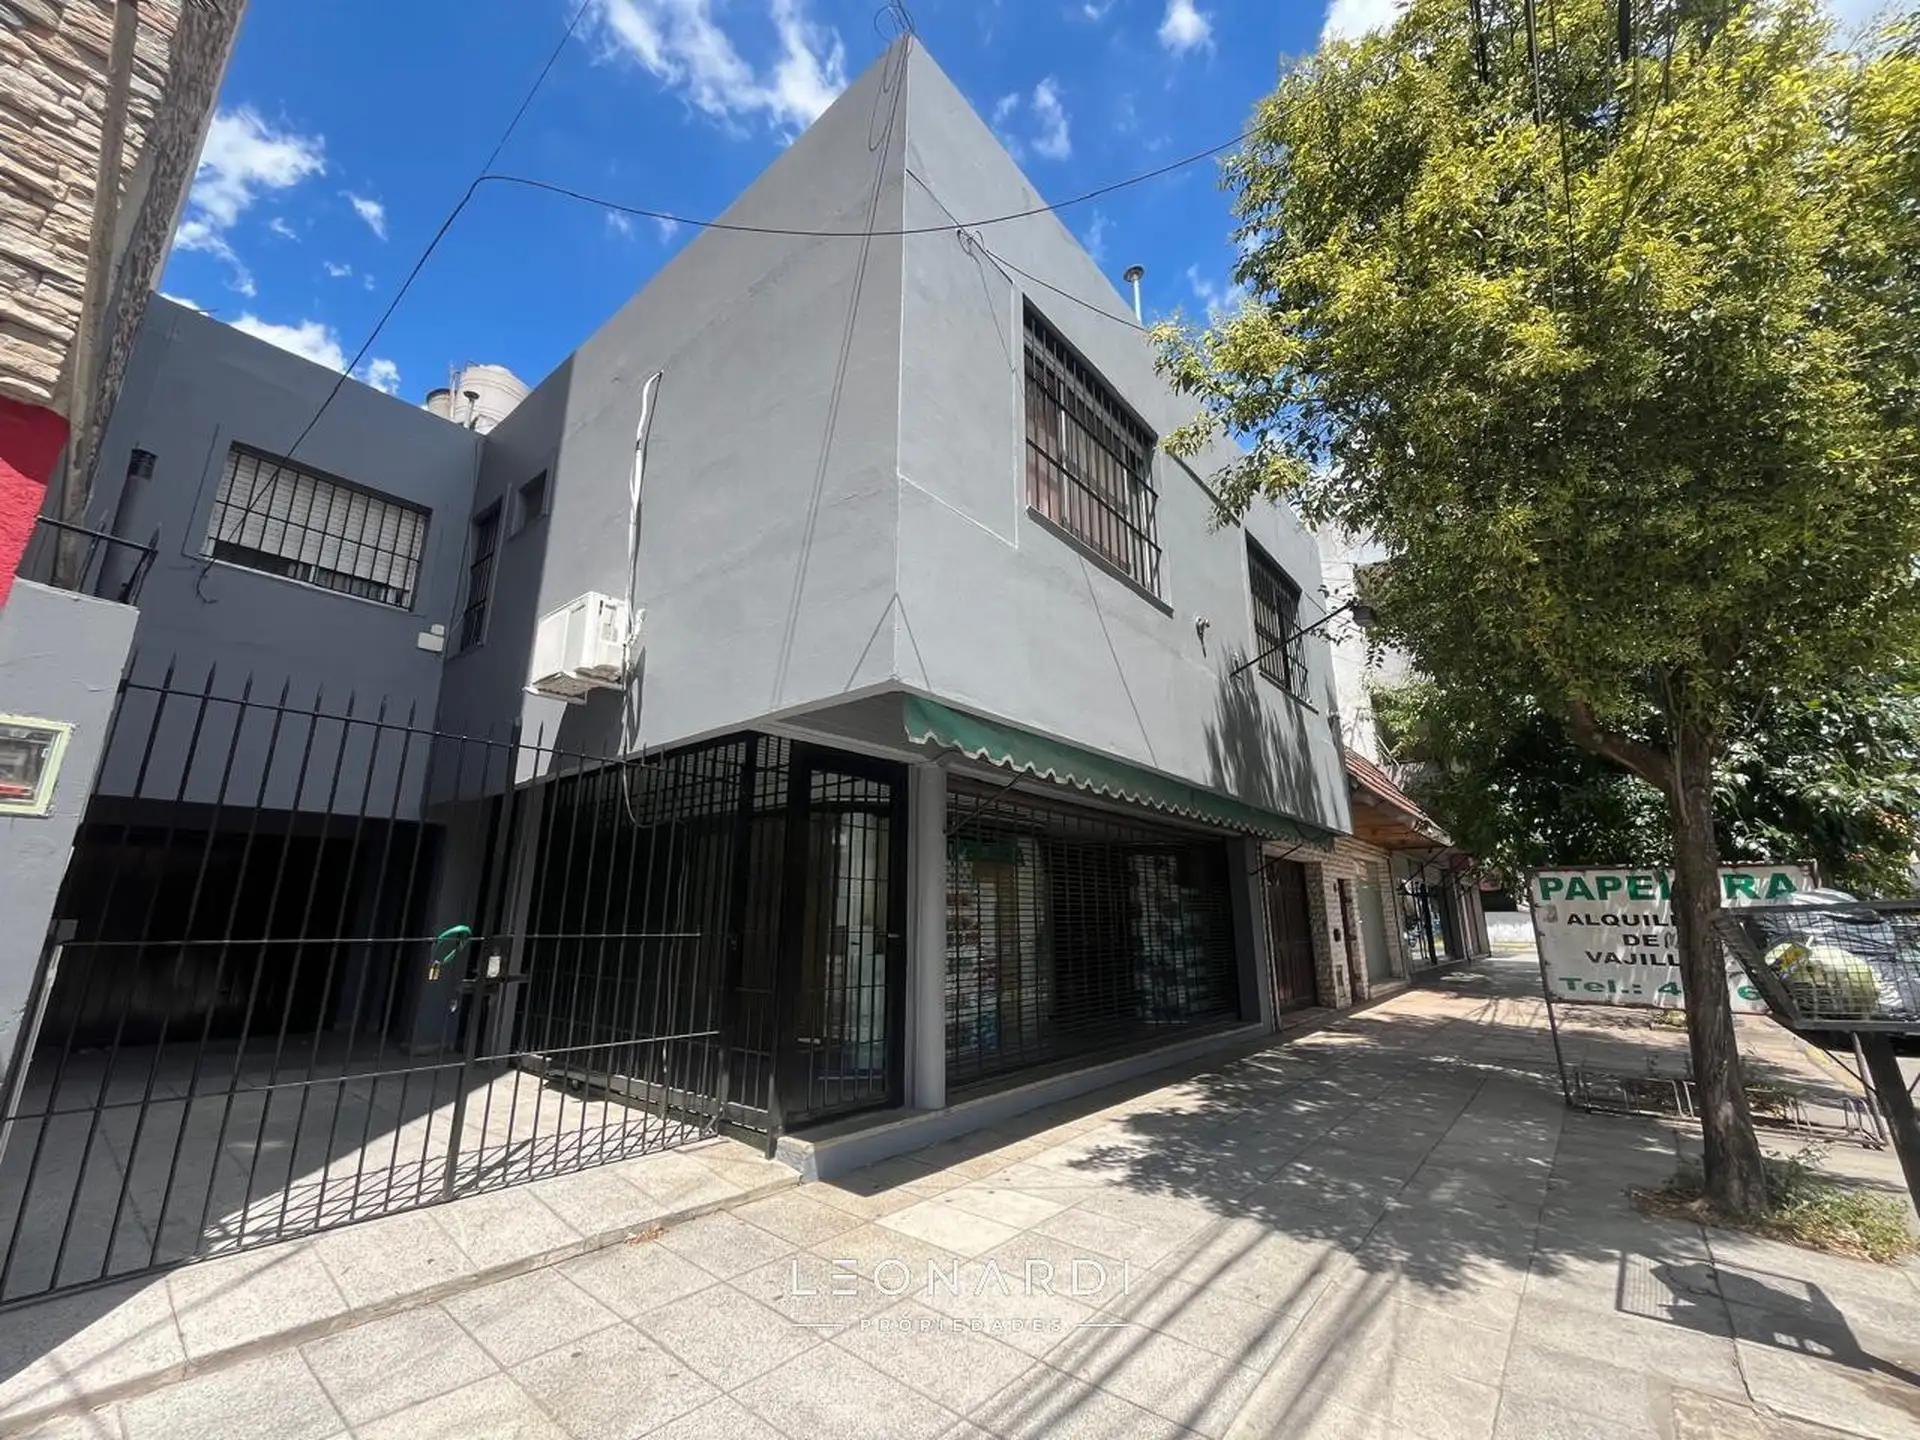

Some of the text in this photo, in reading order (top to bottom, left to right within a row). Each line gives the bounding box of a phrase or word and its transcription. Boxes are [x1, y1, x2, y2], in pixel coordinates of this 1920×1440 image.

[1538, 873, 1797, 900] PAPERA
[1567, 913, 1677, 927] ALQUIL
[1622, 934, 1660, 947] DE
[1585, 951, 1681, 967] VAJILL
[1559, 977, 1642, 994] Tel.:
